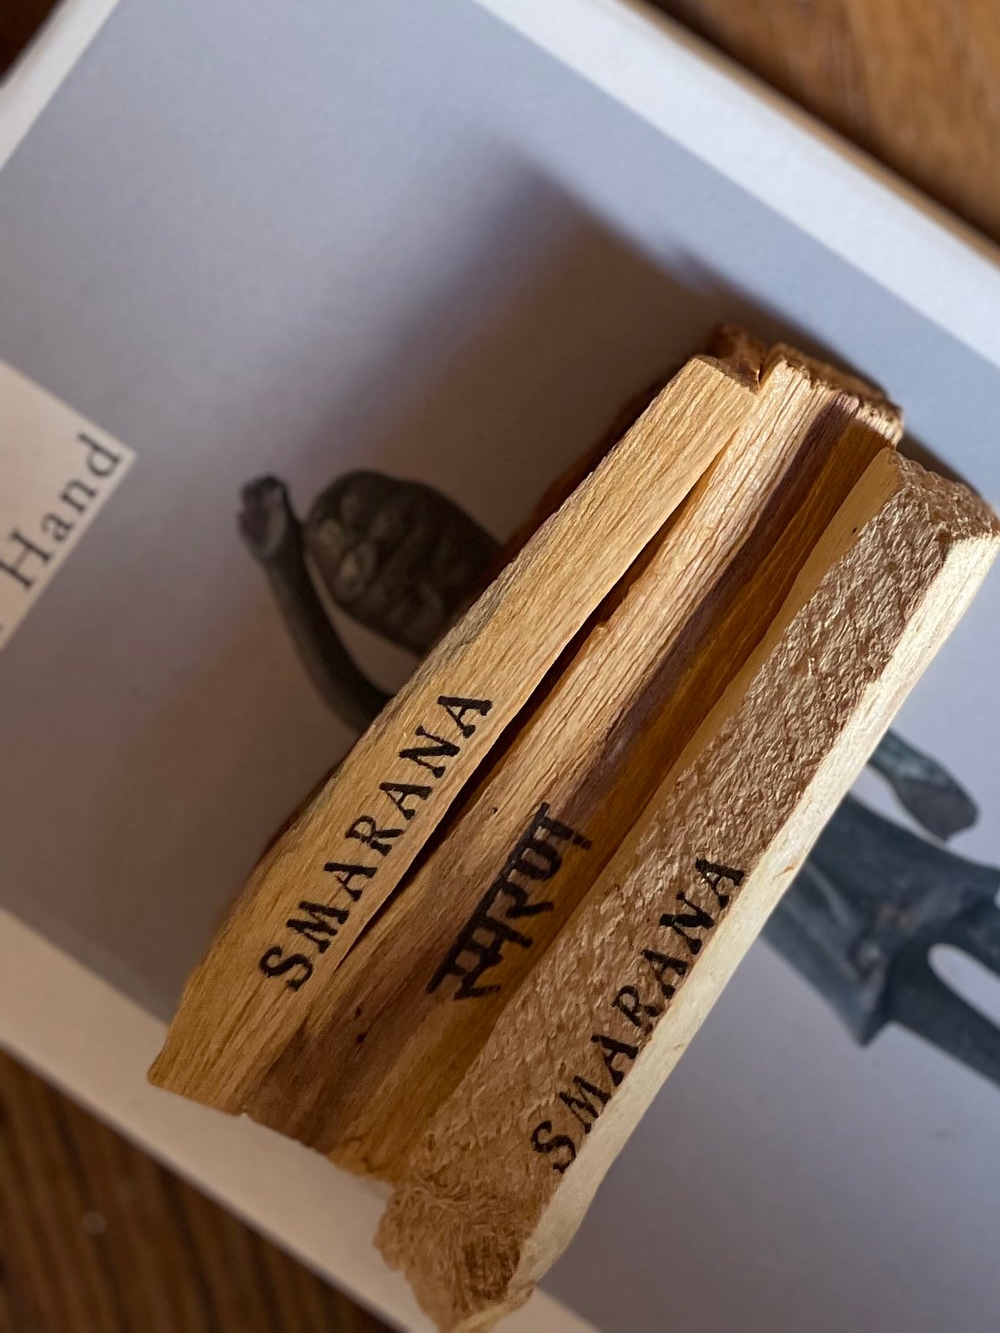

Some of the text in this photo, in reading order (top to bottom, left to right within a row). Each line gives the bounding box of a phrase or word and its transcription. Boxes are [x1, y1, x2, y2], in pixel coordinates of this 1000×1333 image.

[0, 430, 124, 592] Hand
[258, 694, 493, 992] SMARANA
[426, 801, 592, 1001] स्मरण
[529, 857, 746, 1174] SMARANA
